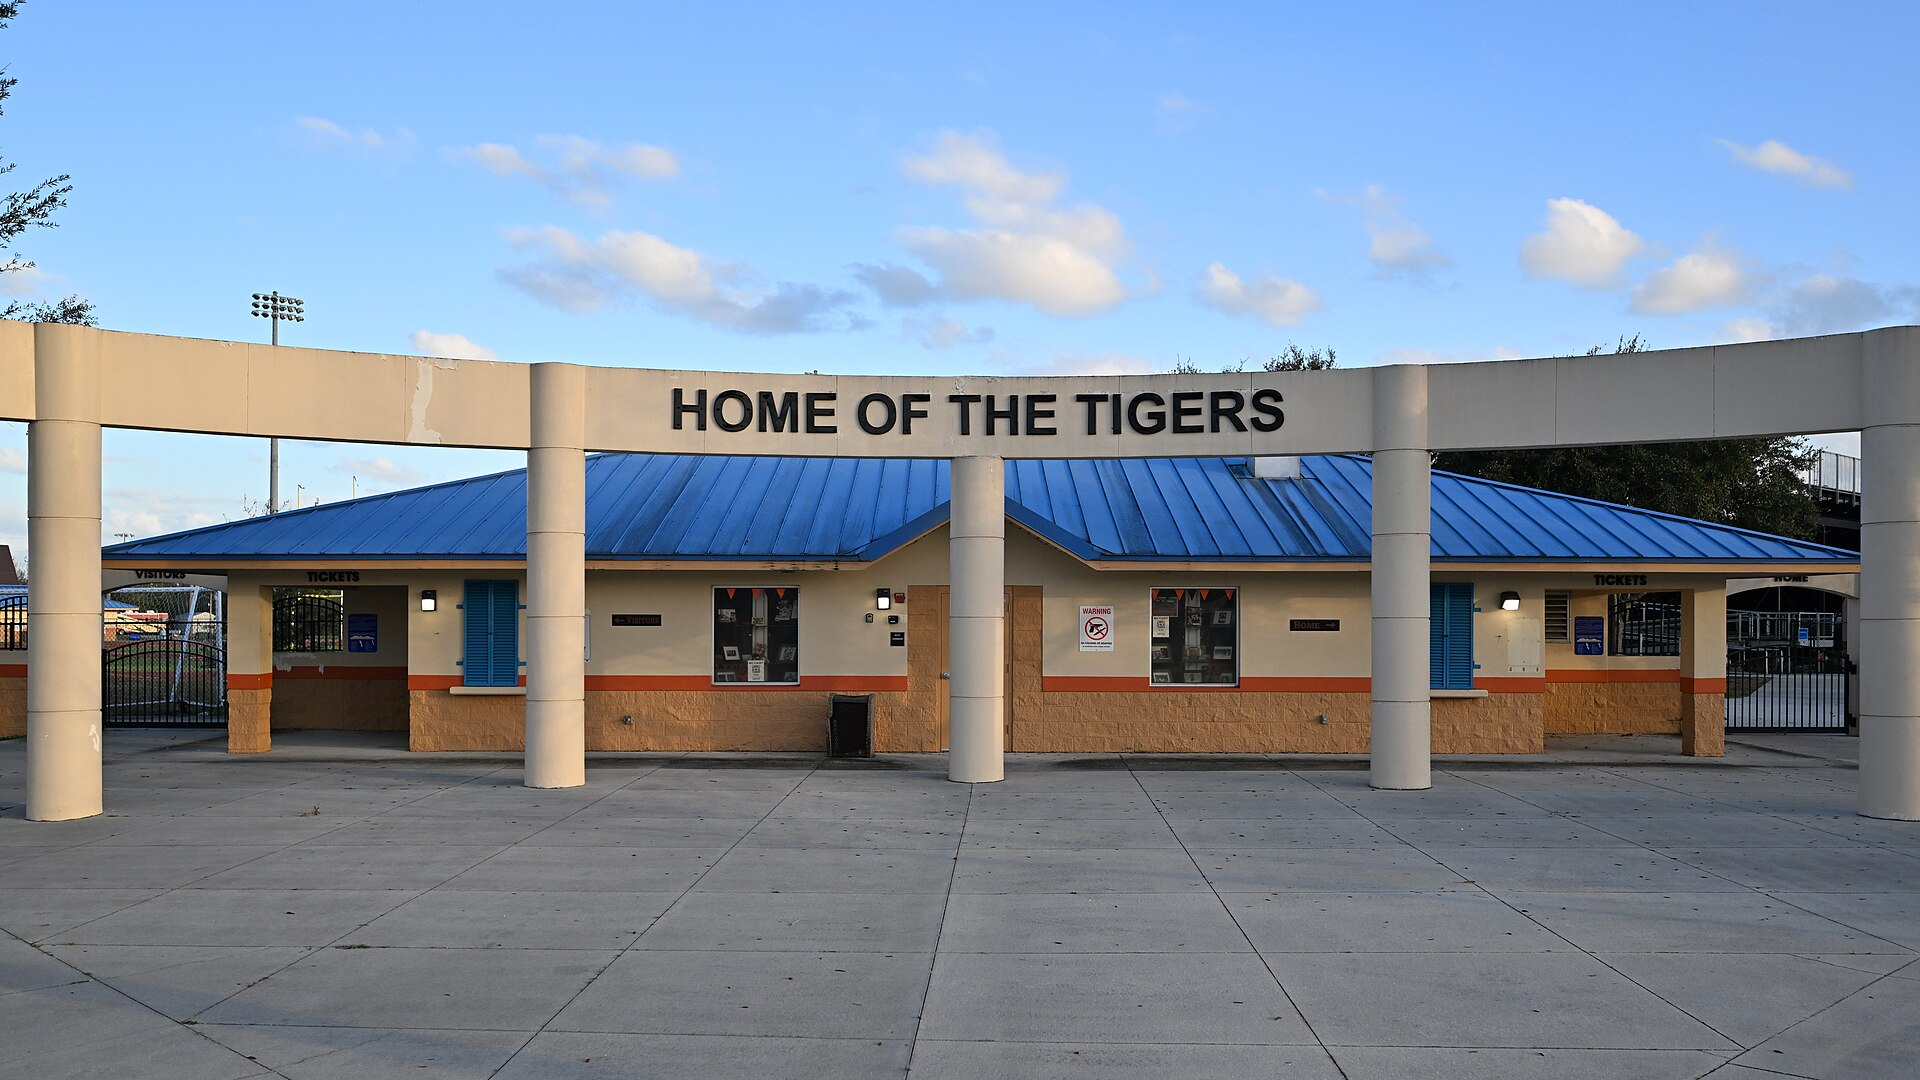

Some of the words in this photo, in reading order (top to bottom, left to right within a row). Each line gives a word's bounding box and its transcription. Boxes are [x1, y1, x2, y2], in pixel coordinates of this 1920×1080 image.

[673, 388, 837, 433] HOME
[858, 393, 930, 435] OF
[949, 395, 1057, 435] THE
[1076, 389, 1284, 435] TIGERS
[306, 571, 360, 582] TICKETS
[1593, 575, 1647, 586] TICKETS
[1082, 607, 1112, 615] WARNING
